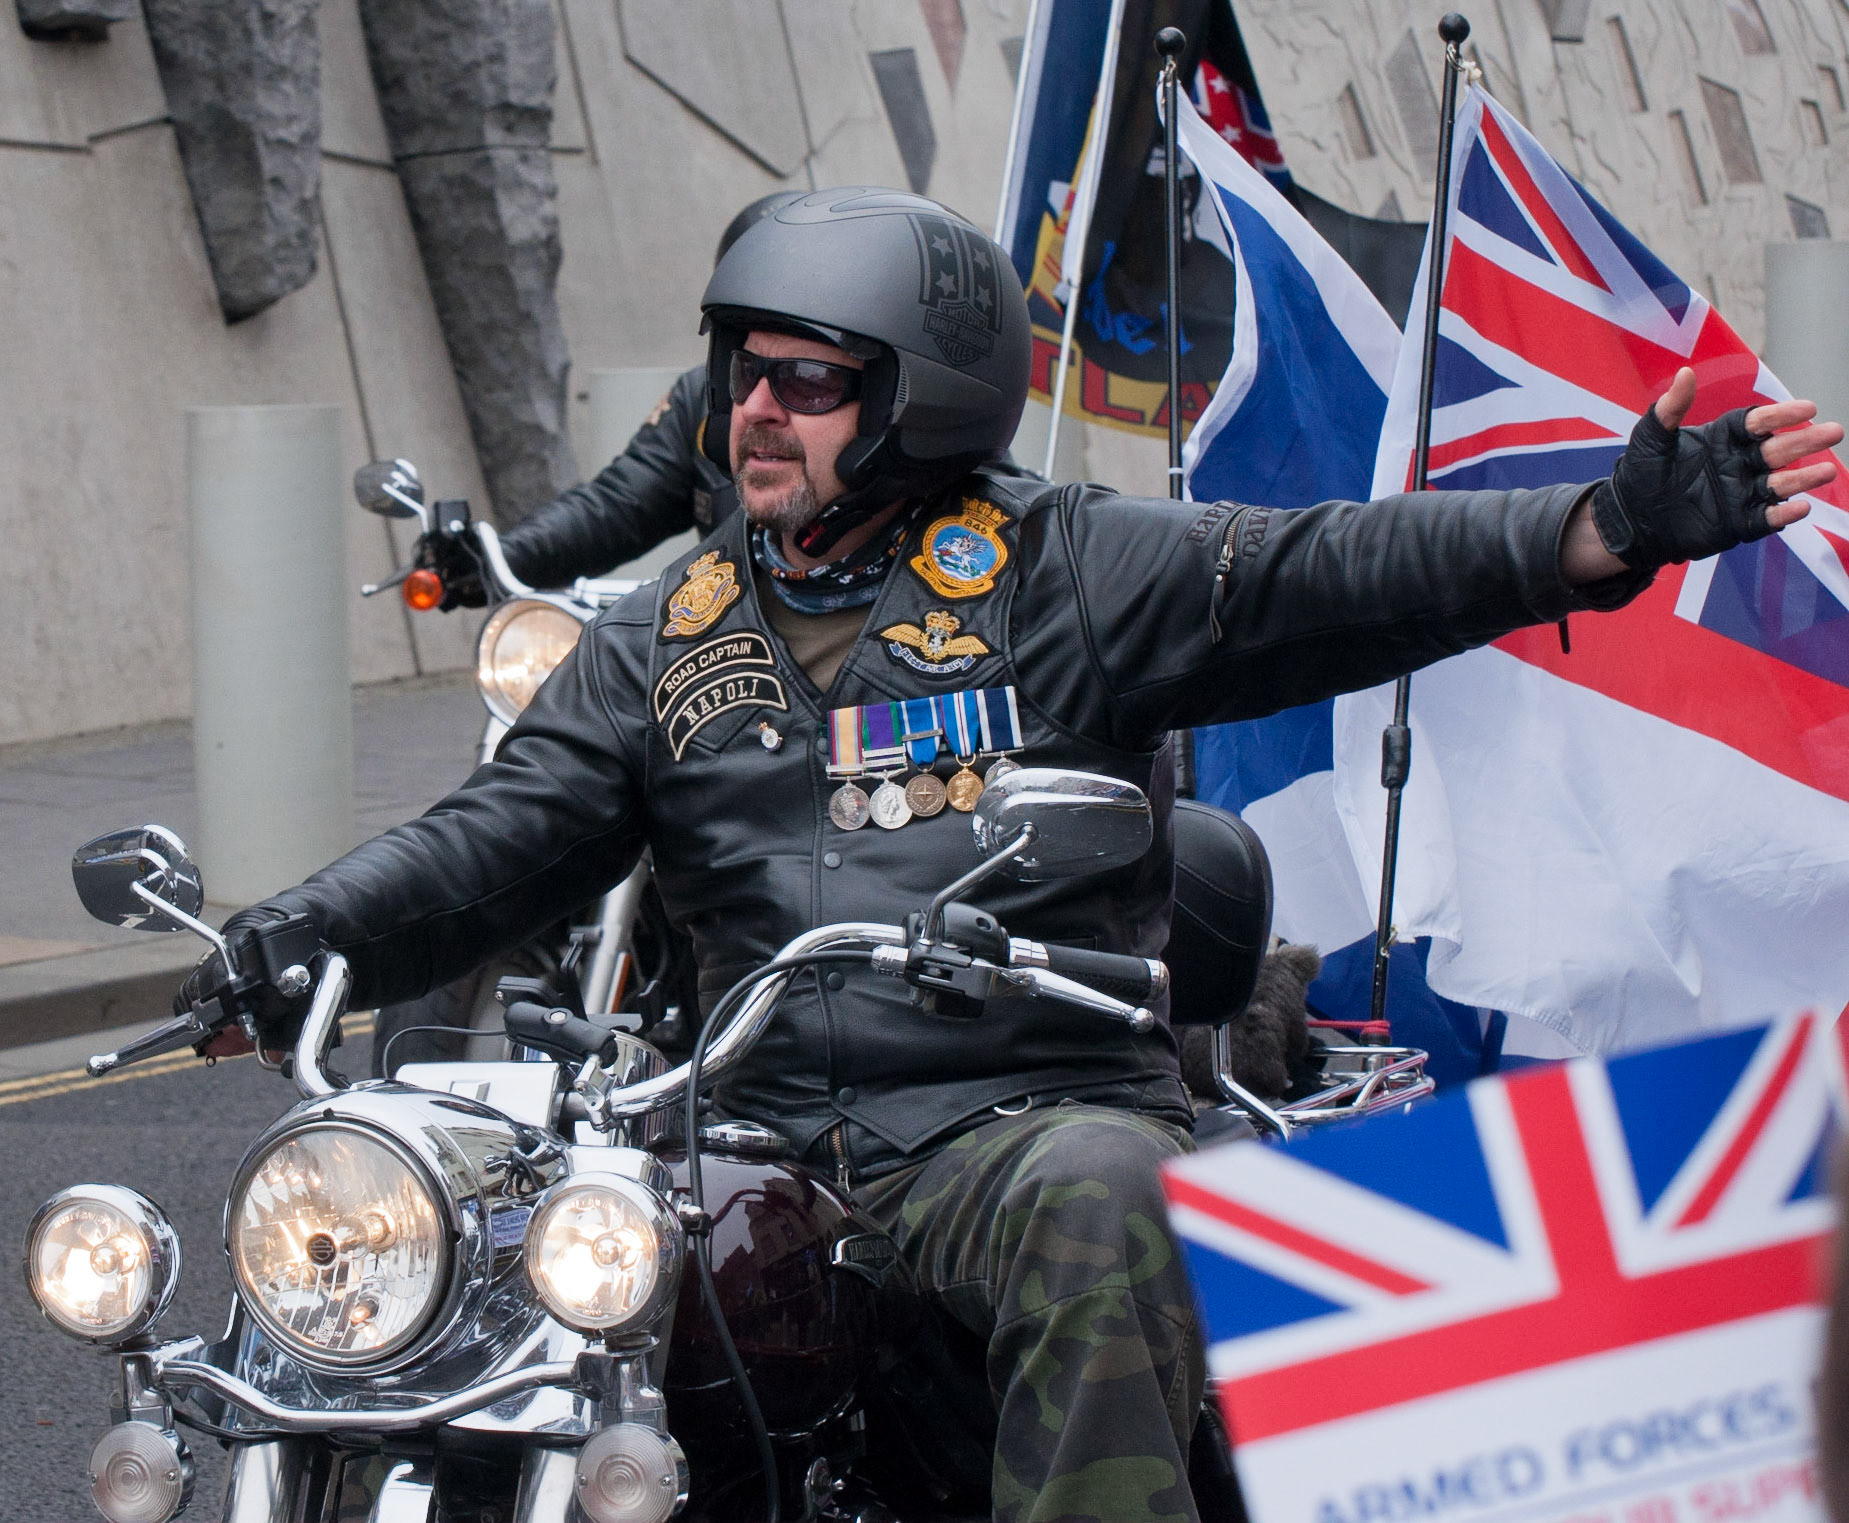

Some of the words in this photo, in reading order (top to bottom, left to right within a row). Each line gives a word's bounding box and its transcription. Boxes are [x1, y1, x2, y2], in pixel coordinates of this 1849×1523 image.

[964, 518, 988, 535] 846
[664, 663, 697, 694] ROAD
[698, 641, 752, 668] CAPTAIN
[682, 678, 759, 726] NAPOLI
[1314, 1444, 1546, 1523] ARMED
[1563, 1381, 1799, 1478] FORCES
